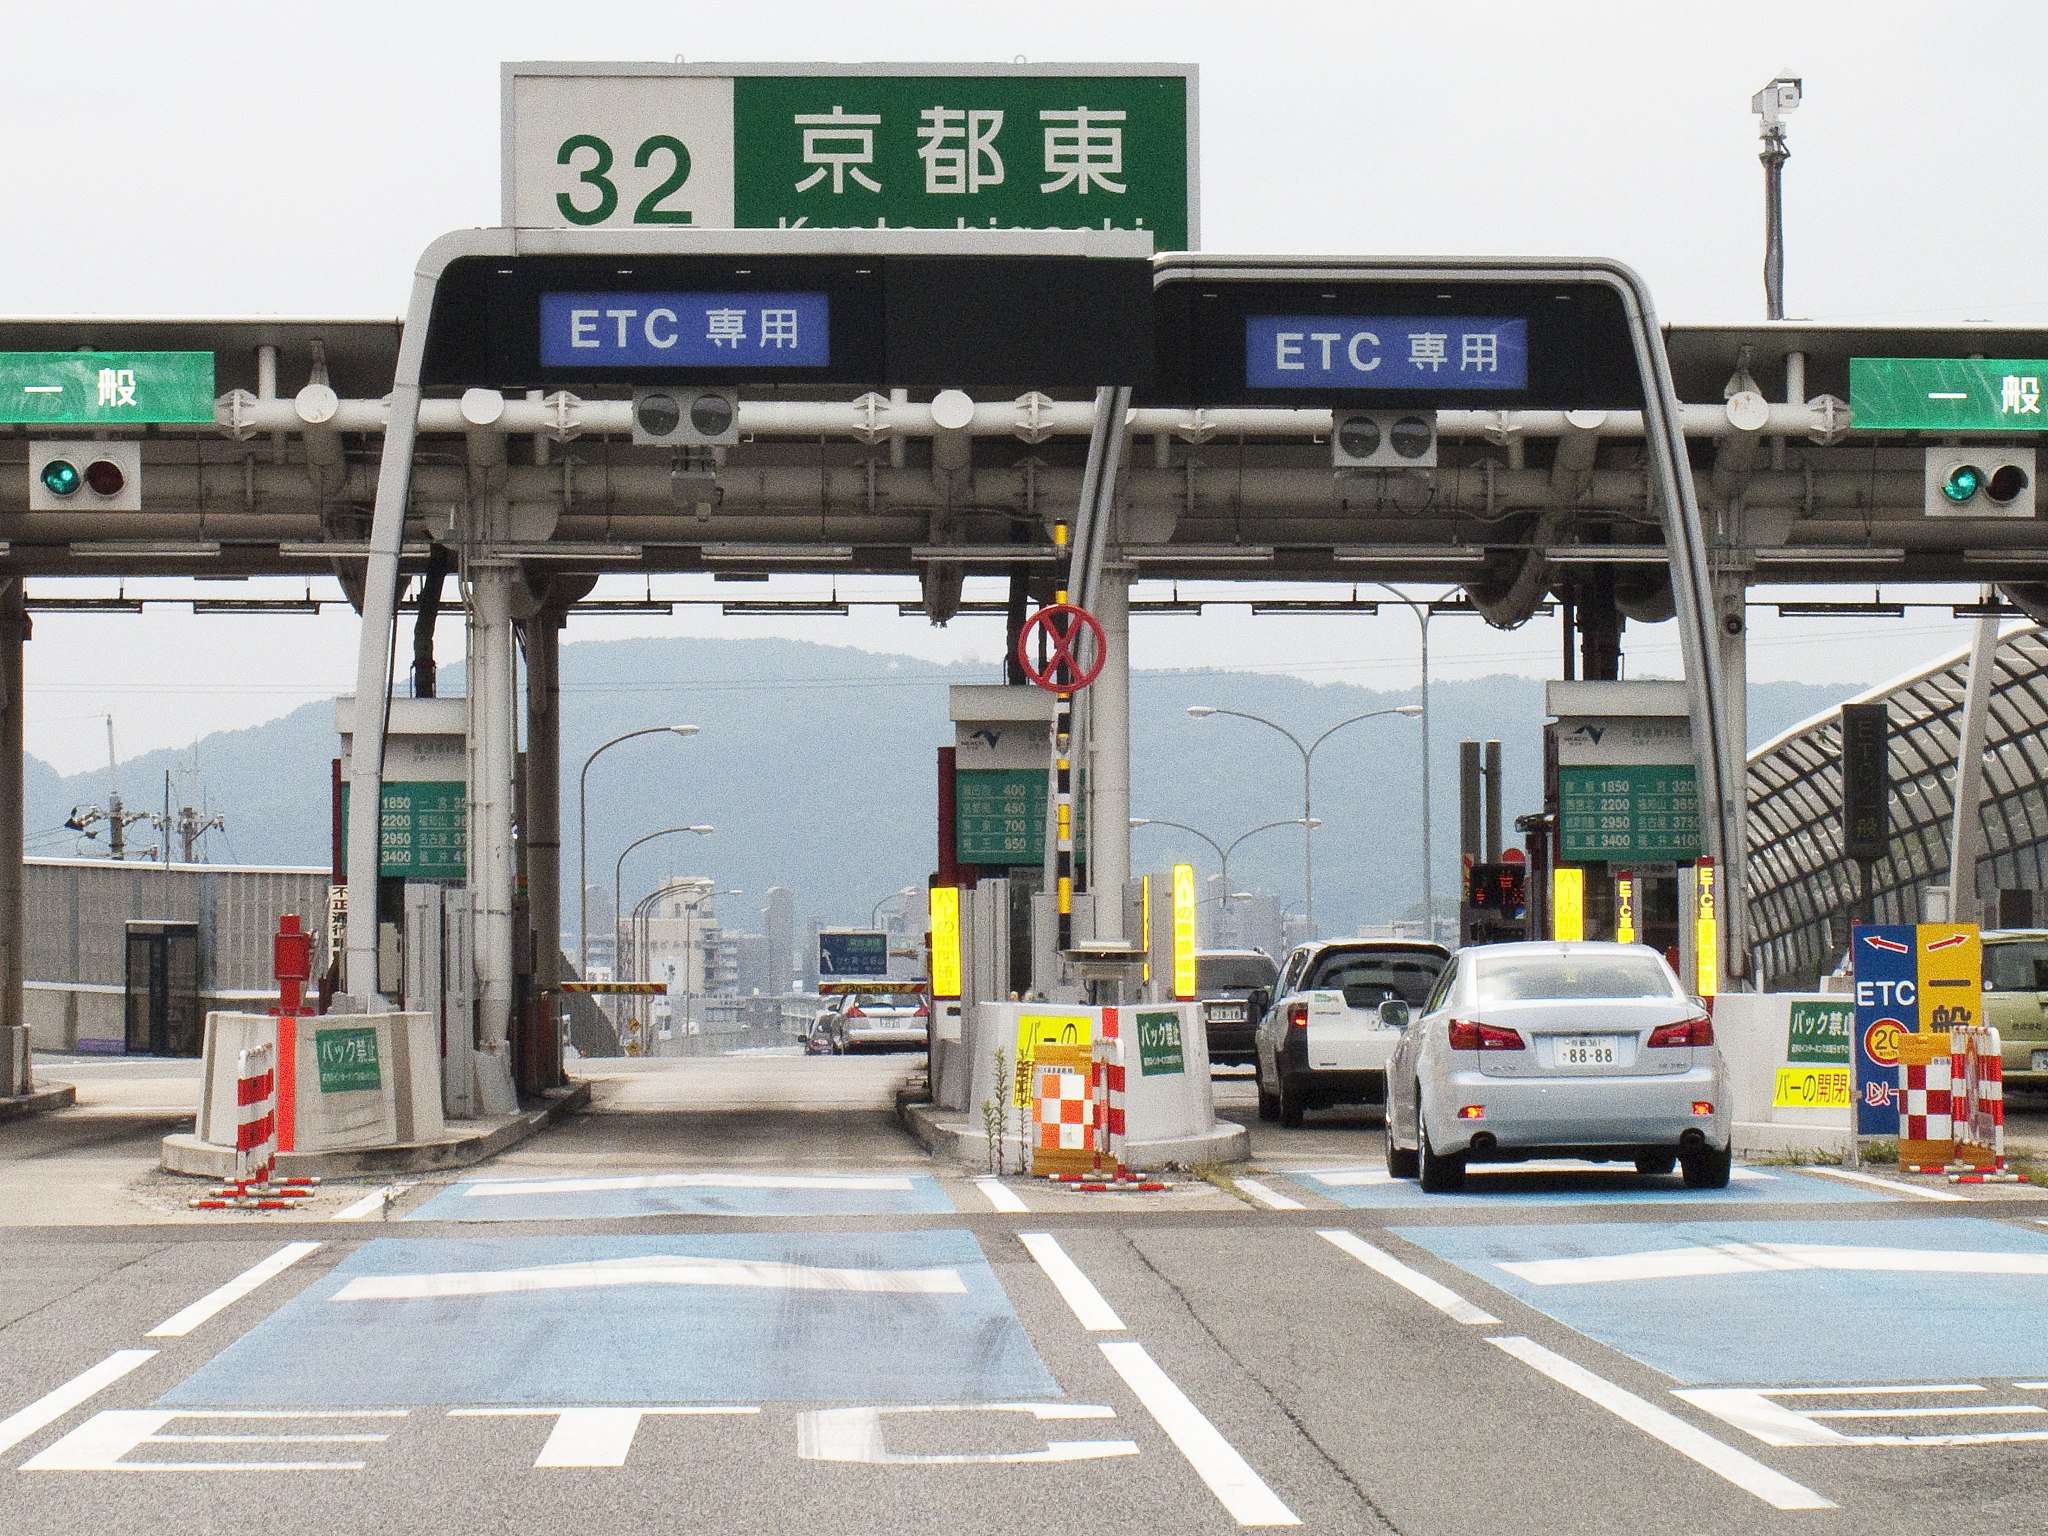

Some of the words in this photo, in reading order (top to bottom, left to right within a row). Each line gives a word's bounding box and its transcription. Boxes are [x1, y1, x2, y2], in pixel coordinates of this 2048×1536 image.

[794, 105, 1127, 195] 京都東
[555, 133, 693, 226] 32
[570, 308, 679, 349] ETC
[704, 307, 800, 349] 専用
[1275, 332, 1382, 372] ETC
[1406, 331, 1500, 372] 専用
[24, 367, 138, 408] 一般
[1927, 374, 2041, 416] 一般
[1003, 784, 1026, 797] 400
[1601, 781, 1630, 793] 1850
[1672, 781, 1697, 793] 320
[382, 797, 411, 809] 1850
[1003, 802, 1026, 815] 450
[1601, 799, 1630, 811] 2200
[382, 815, 411, 827] 2200
[1004, 820, 1026, 832] 700
[1601, 817, 1630, 829] 2950
[382, 832, 411, 845] 2950
[1004, 838, 1027, 850] 950
[1601, 835, 1631, 847] 3400
[382, 850, 411, 863] 3400
[1857, 980, 1916, 1007] ETC
[1874, 1030, 1900, 1051] 20
[322, 1037, 377, 1063] バック禁止
[1569, 1048, 1613, 1063] 88-88
[1775, 1072, 1852, 1105] バーの開閉
[18, 1402, 1140, 1472] ETC
